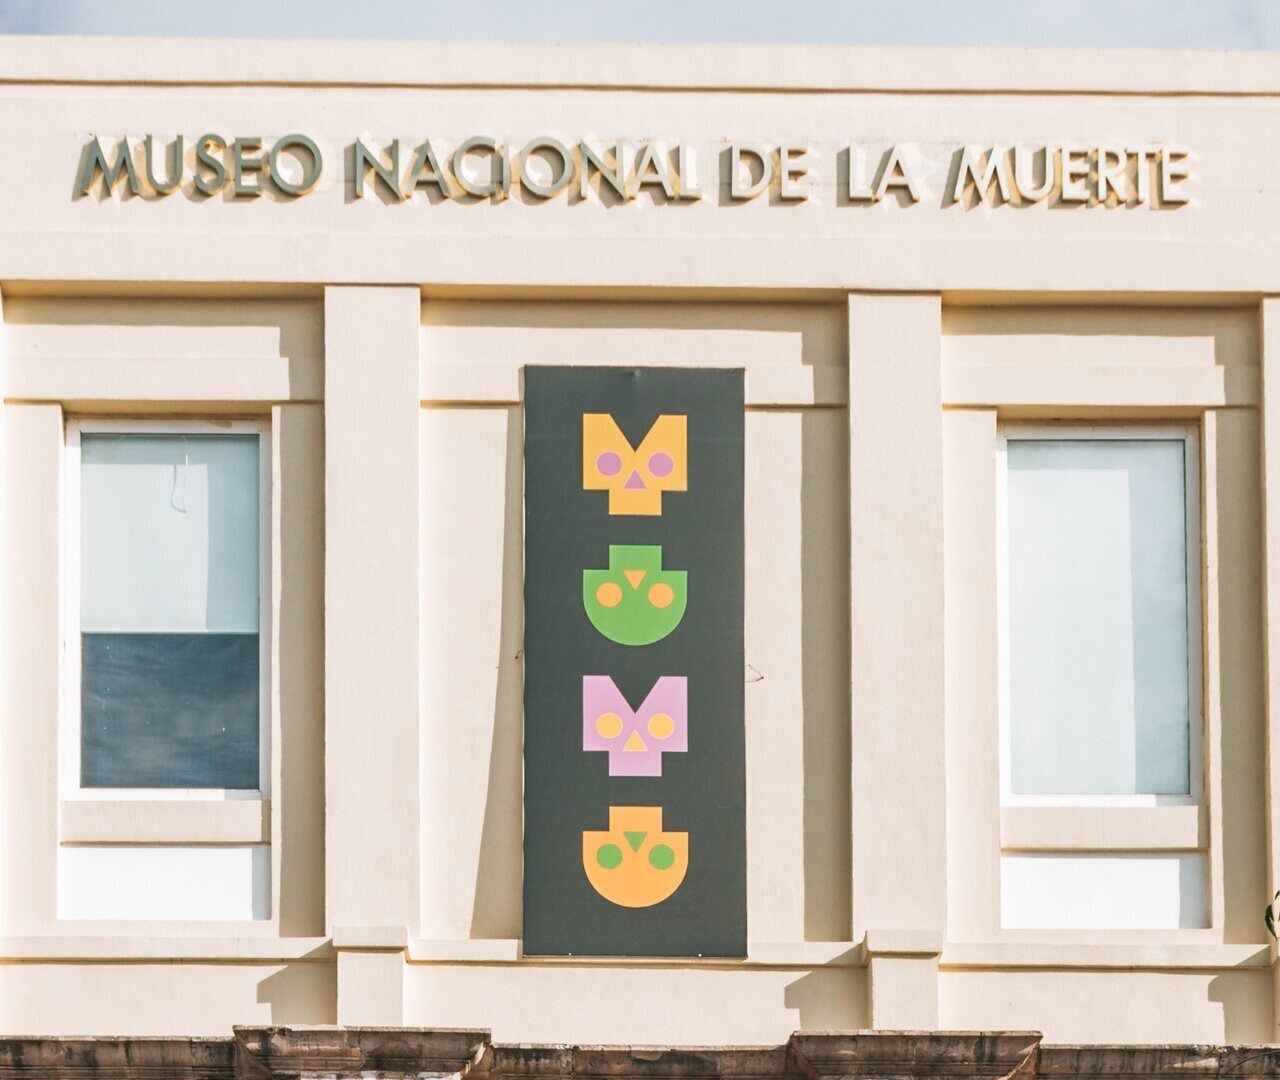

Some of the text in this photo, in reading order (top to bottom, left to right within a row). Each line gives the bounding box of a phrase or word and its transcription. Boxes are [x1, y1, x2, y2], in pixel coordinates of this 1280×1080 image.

[75, 133, 1192, 207] MUSEO NACIONAL DE LA MUERTE
